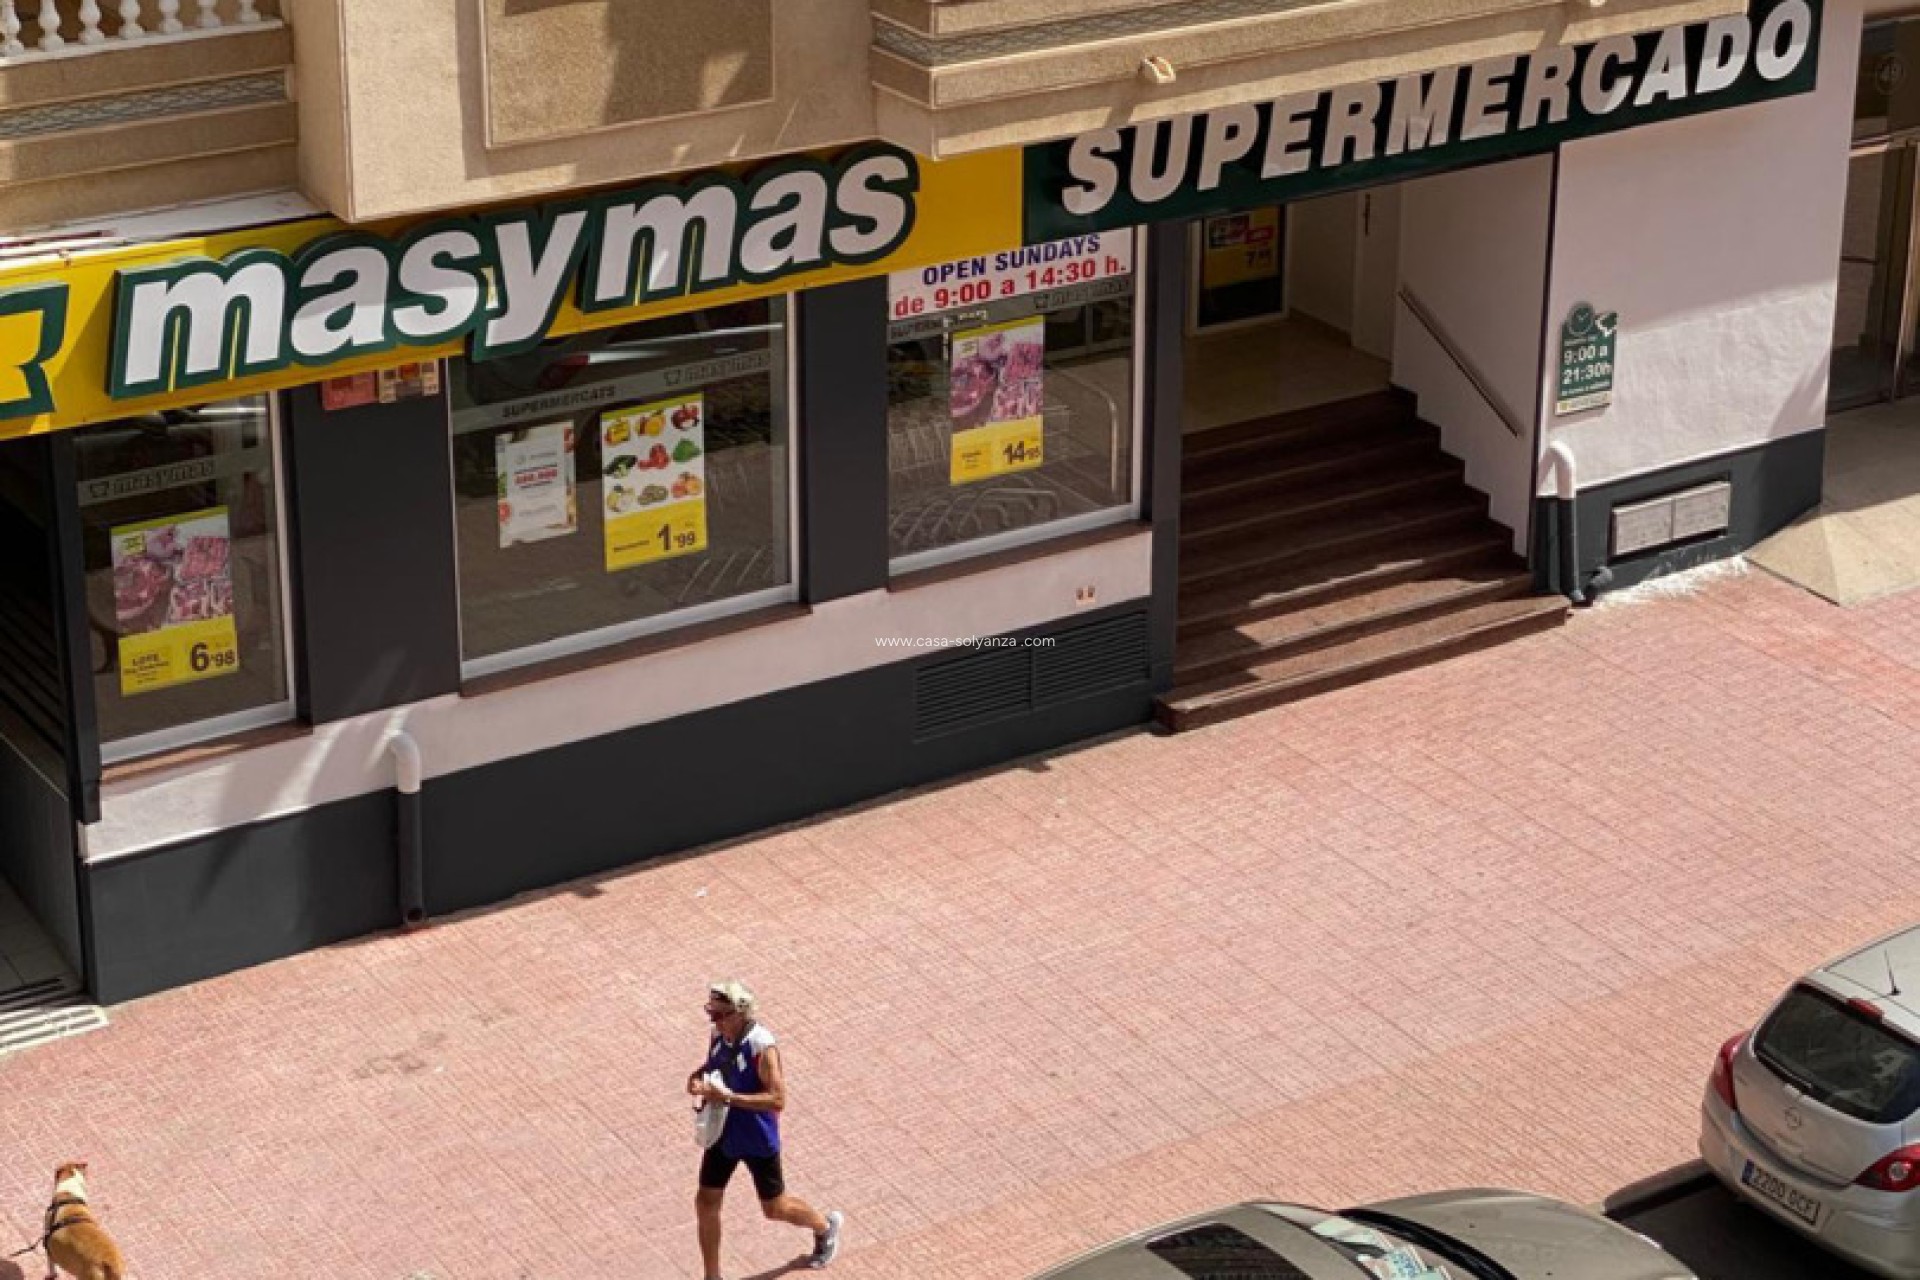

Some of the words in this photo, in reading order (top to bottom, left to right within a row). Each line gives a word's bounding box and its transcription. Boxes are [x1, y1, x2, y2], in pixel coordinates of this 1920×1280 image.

[1062, 1, 1810, 215] SUPERMERCADO
[125, 153, 914, 384] masymas
[895, 296, 925, 317] de
[934, 279, 992, 309] 9:00
[1001, 278, 1016, 296] a
[1025, 257, 1096, 290] 14:30
[1104, 255, 1128, 275] h.
[923, 257, 987, 286] OPEN
[995, 234, 1101, 271] SUNDAYS
[1562, 362, 1613, 385] 21:30h
[1564, 345, 1596, 366] 9:00
